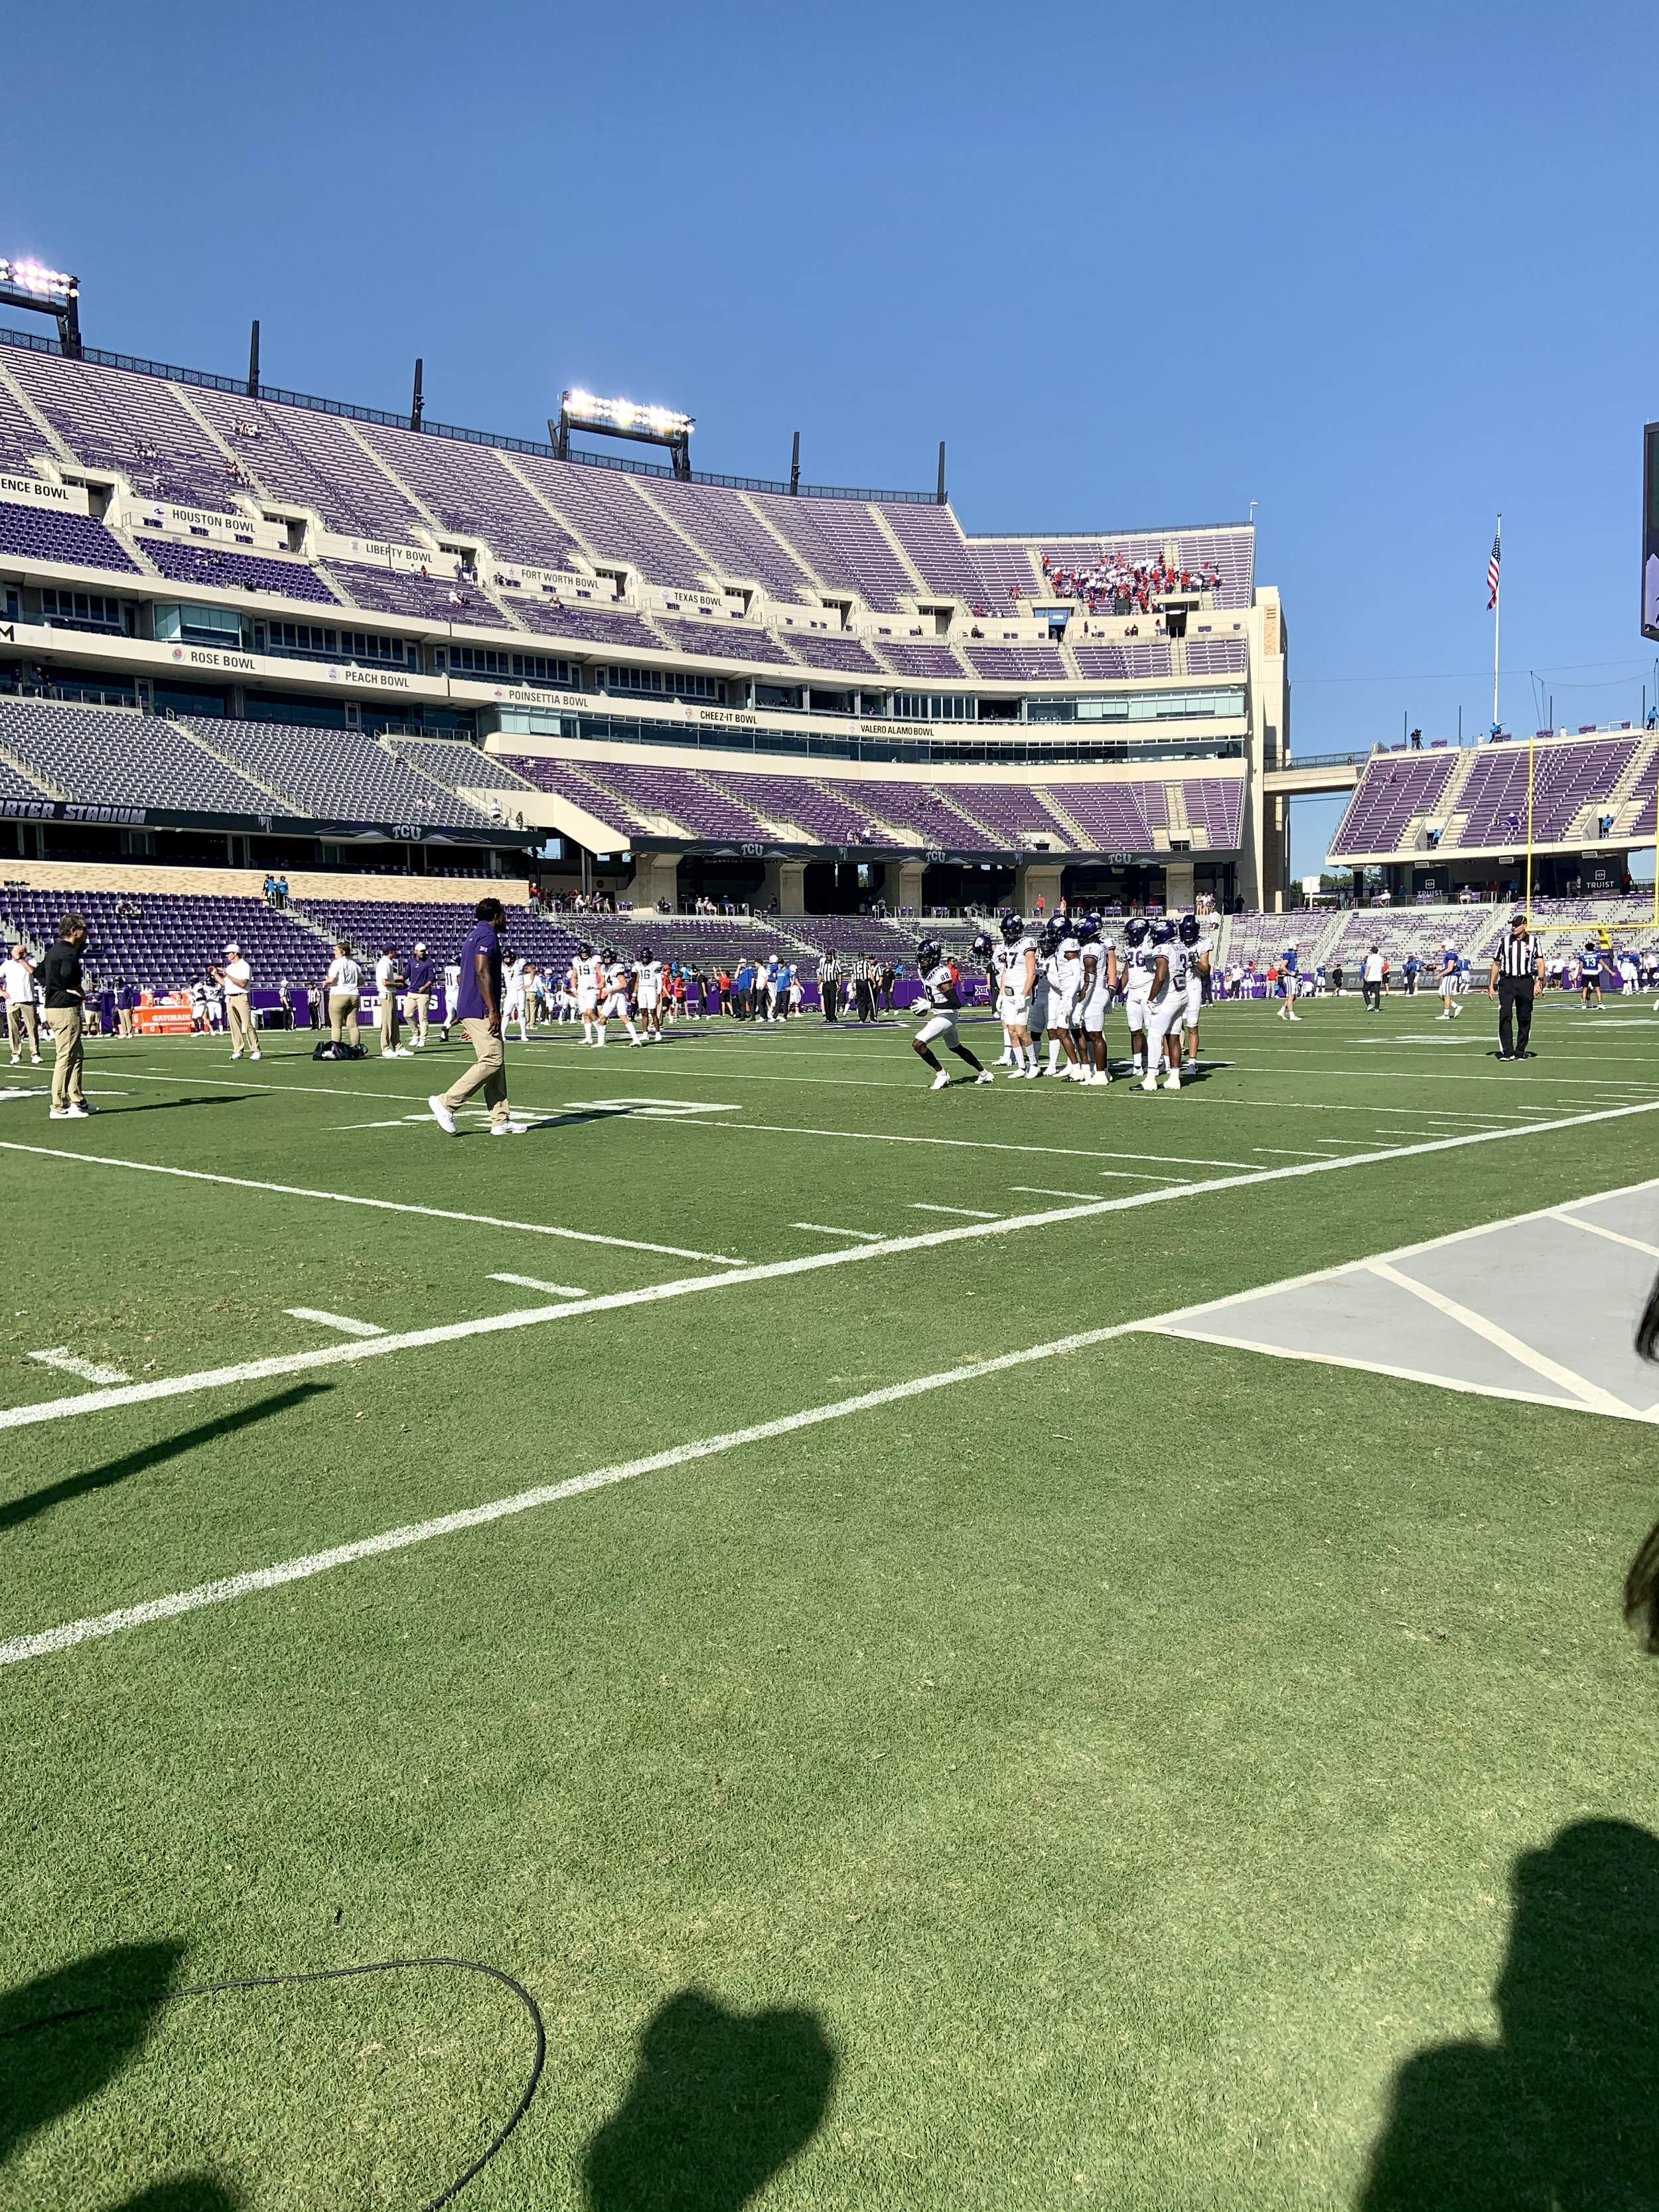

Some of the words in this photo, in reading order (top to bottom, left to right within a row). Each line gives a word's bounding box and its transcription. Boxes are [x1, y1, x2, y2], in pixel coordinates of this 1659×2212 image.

[1, 479, 31, 493] ENCE
[35, 484, 69, 500] BOWL
[173, 509, 222, 527] HOUSTON
[225, 519, 255, 533] BOWL
[366, 544, 403, 558] LIBERTY
[406, 550, 433, 563] BOWL
[522, 569, 541, 580] FORT
[543, 573, 573, 585] WORTH
[576, 577, 599, 589] BOWL
[674, 592, 698, 603] TEXAS
[700, 596, 722, 607] BOWL
[191, 651, 220, 664] ROSE
[223, 656, 255, 670] BOWL
[346, 671, 378, 684] PEACH
[380, 675, 409, 688] BOWL
[509, 690, 560, 704] POINSETTIA
[563, 696, 588, 707] BOWL
[701, 710, 733, 722] CHEEZ-IT
[735, 714, 757, 724] BOWL
[861, 725, 887, 733] VALERO
[888, 726, 912, 735] ALAMO
[914, 727, 934, 736] BOWL
[64, 804, 146, 824] STADIUM
[392, 825, 421, 841] TCU
[741, 843, 763, 857] TCU
[926, 850, 946, 863] TCU
[1108, 853, 1131, 865] TCU
[1127, 950, 1145, 968] 26
[1585, 958, 1597, 967] 13
[508, 970, 514, 981] 7
[579, 965, 590, 976] 19
[640, 969, 650, 980] 16
[857, 964, 863, 974] C
[446, 972, 453, 986] 11
[940, 972, 950, 981] 88
